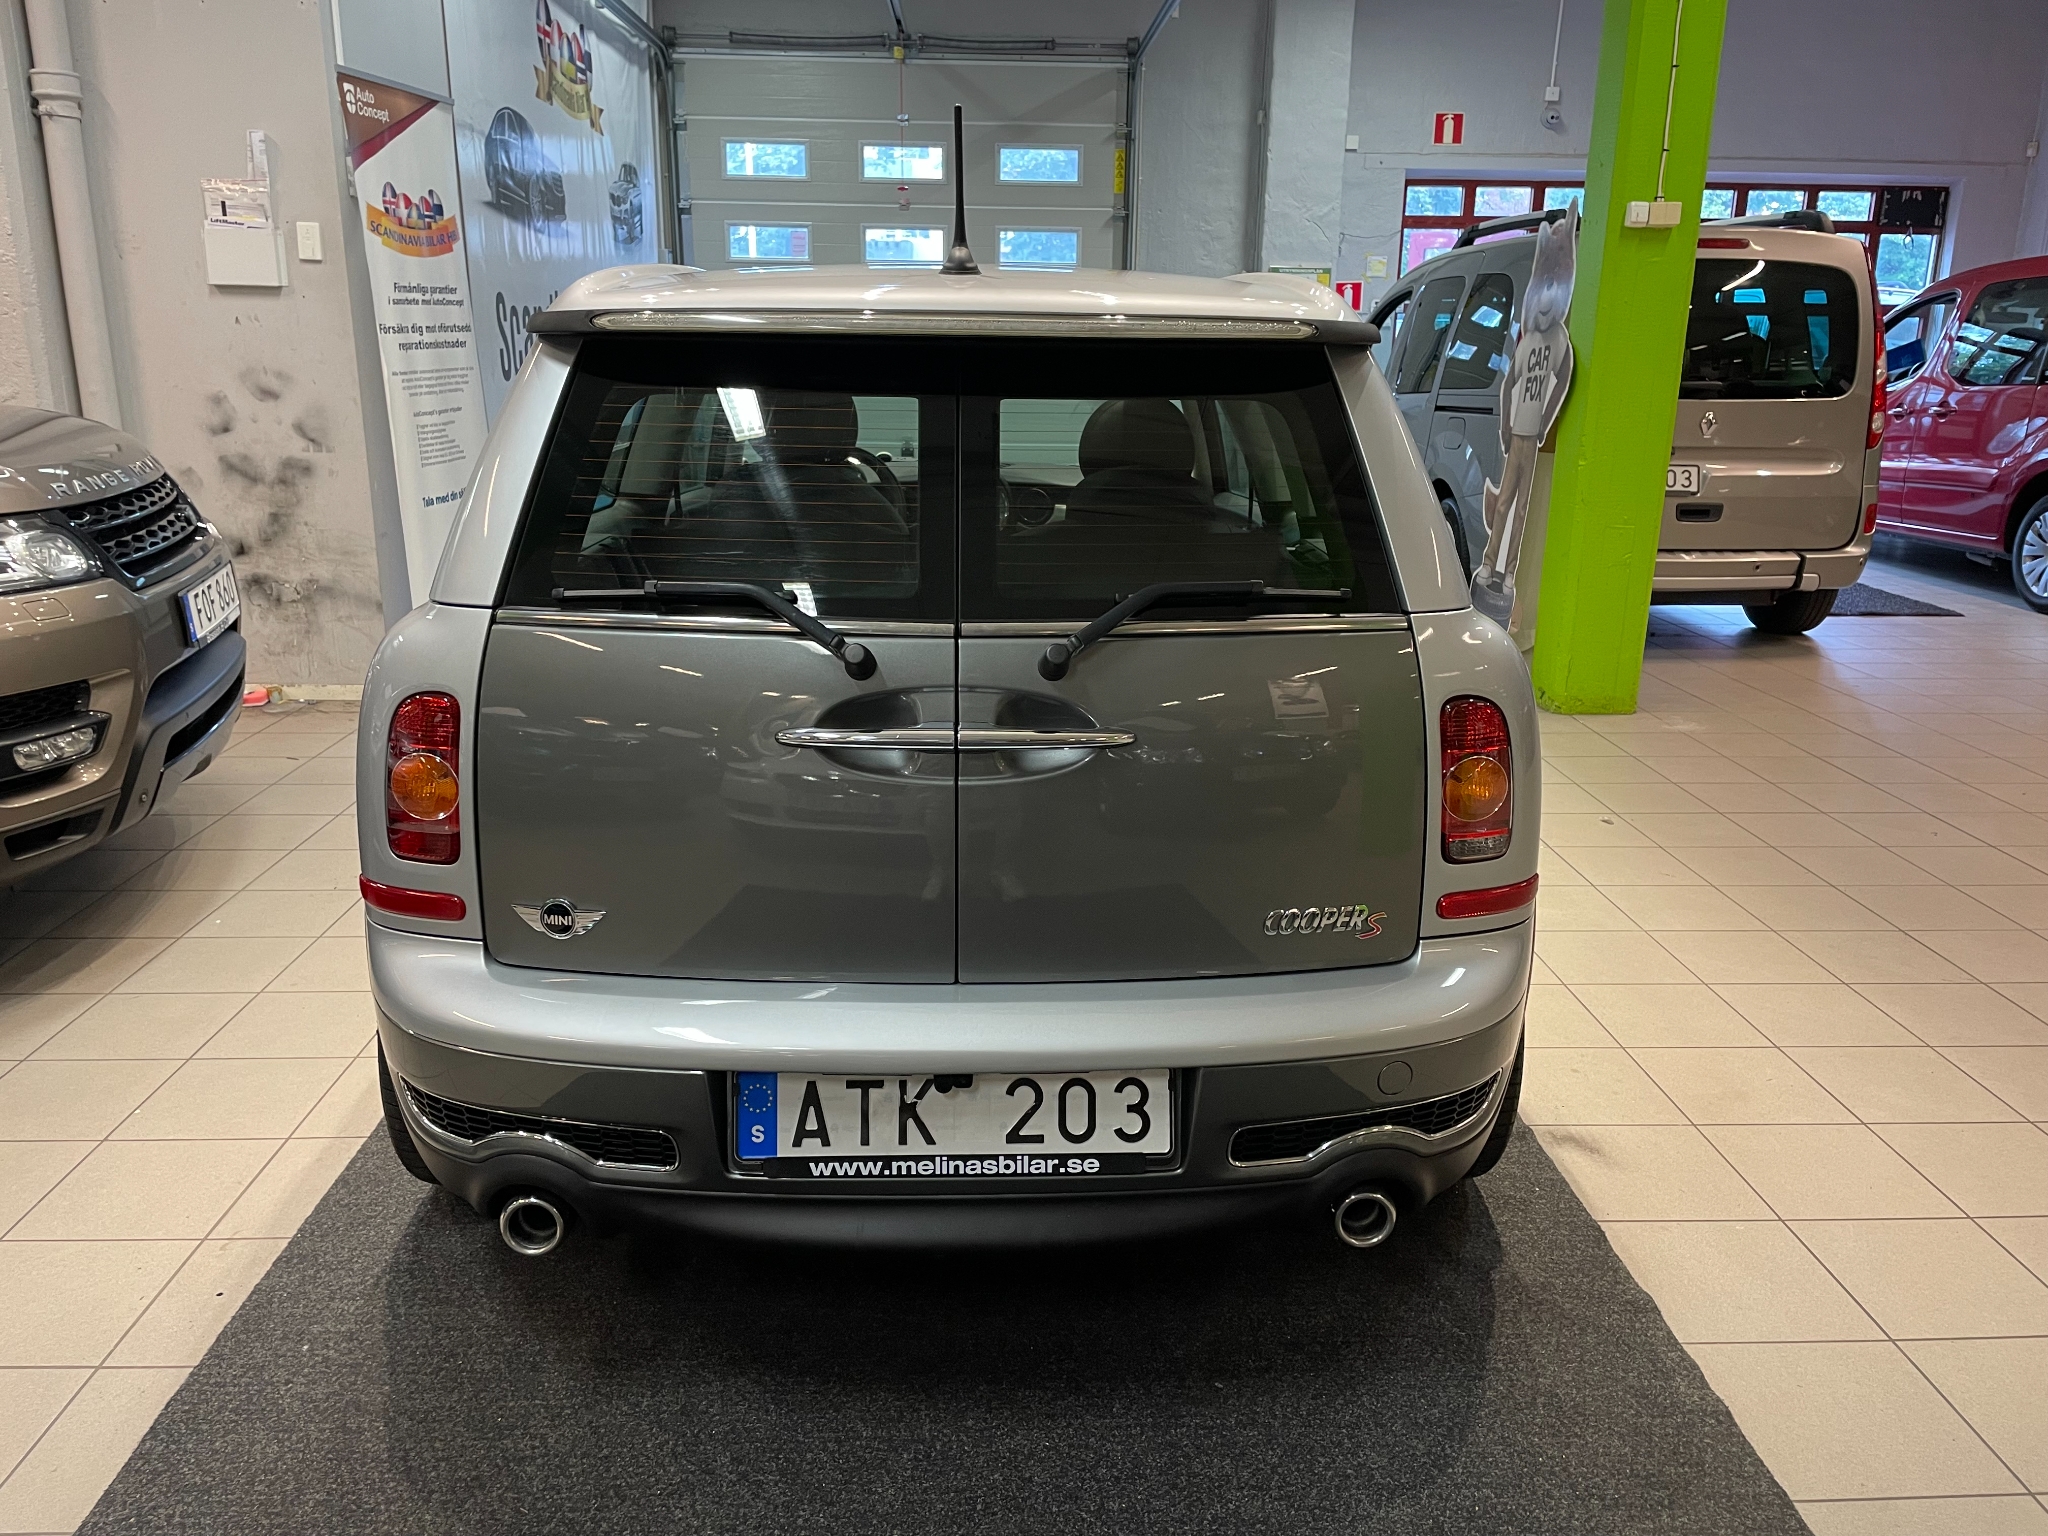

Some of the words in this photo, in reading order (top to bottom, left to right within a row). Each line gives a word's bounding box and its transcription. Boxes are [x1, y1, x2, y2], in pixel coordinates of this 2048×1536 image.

[356, 87, 375, 104] Auto
[357, 101, 390, 124] Concept
[379, 323, 409, 335] Försäkra
[410, 322, 424, 336] dig
[1527, 345, 1551, 374] CAR
[1522, 374, 1546, 403] FOX
[49, 469, 130, 498] RANGE
[435, 491, 450, 505] med
[193, 583, 217, 629] FOF
[215, 571, 235, 612] 860
[543, 913, 573, 926] MINI
[1263, 904, 1369, 936] COOPER
[1354, 911, 1388, 940] S
[792, 1078, 937, 1148] ATK
[1005, 1077, 1151, 1145] 203
[751, 1124, 765, 1143] S
[809, 1155, 1101, 1177] www.melinasbilar.se
